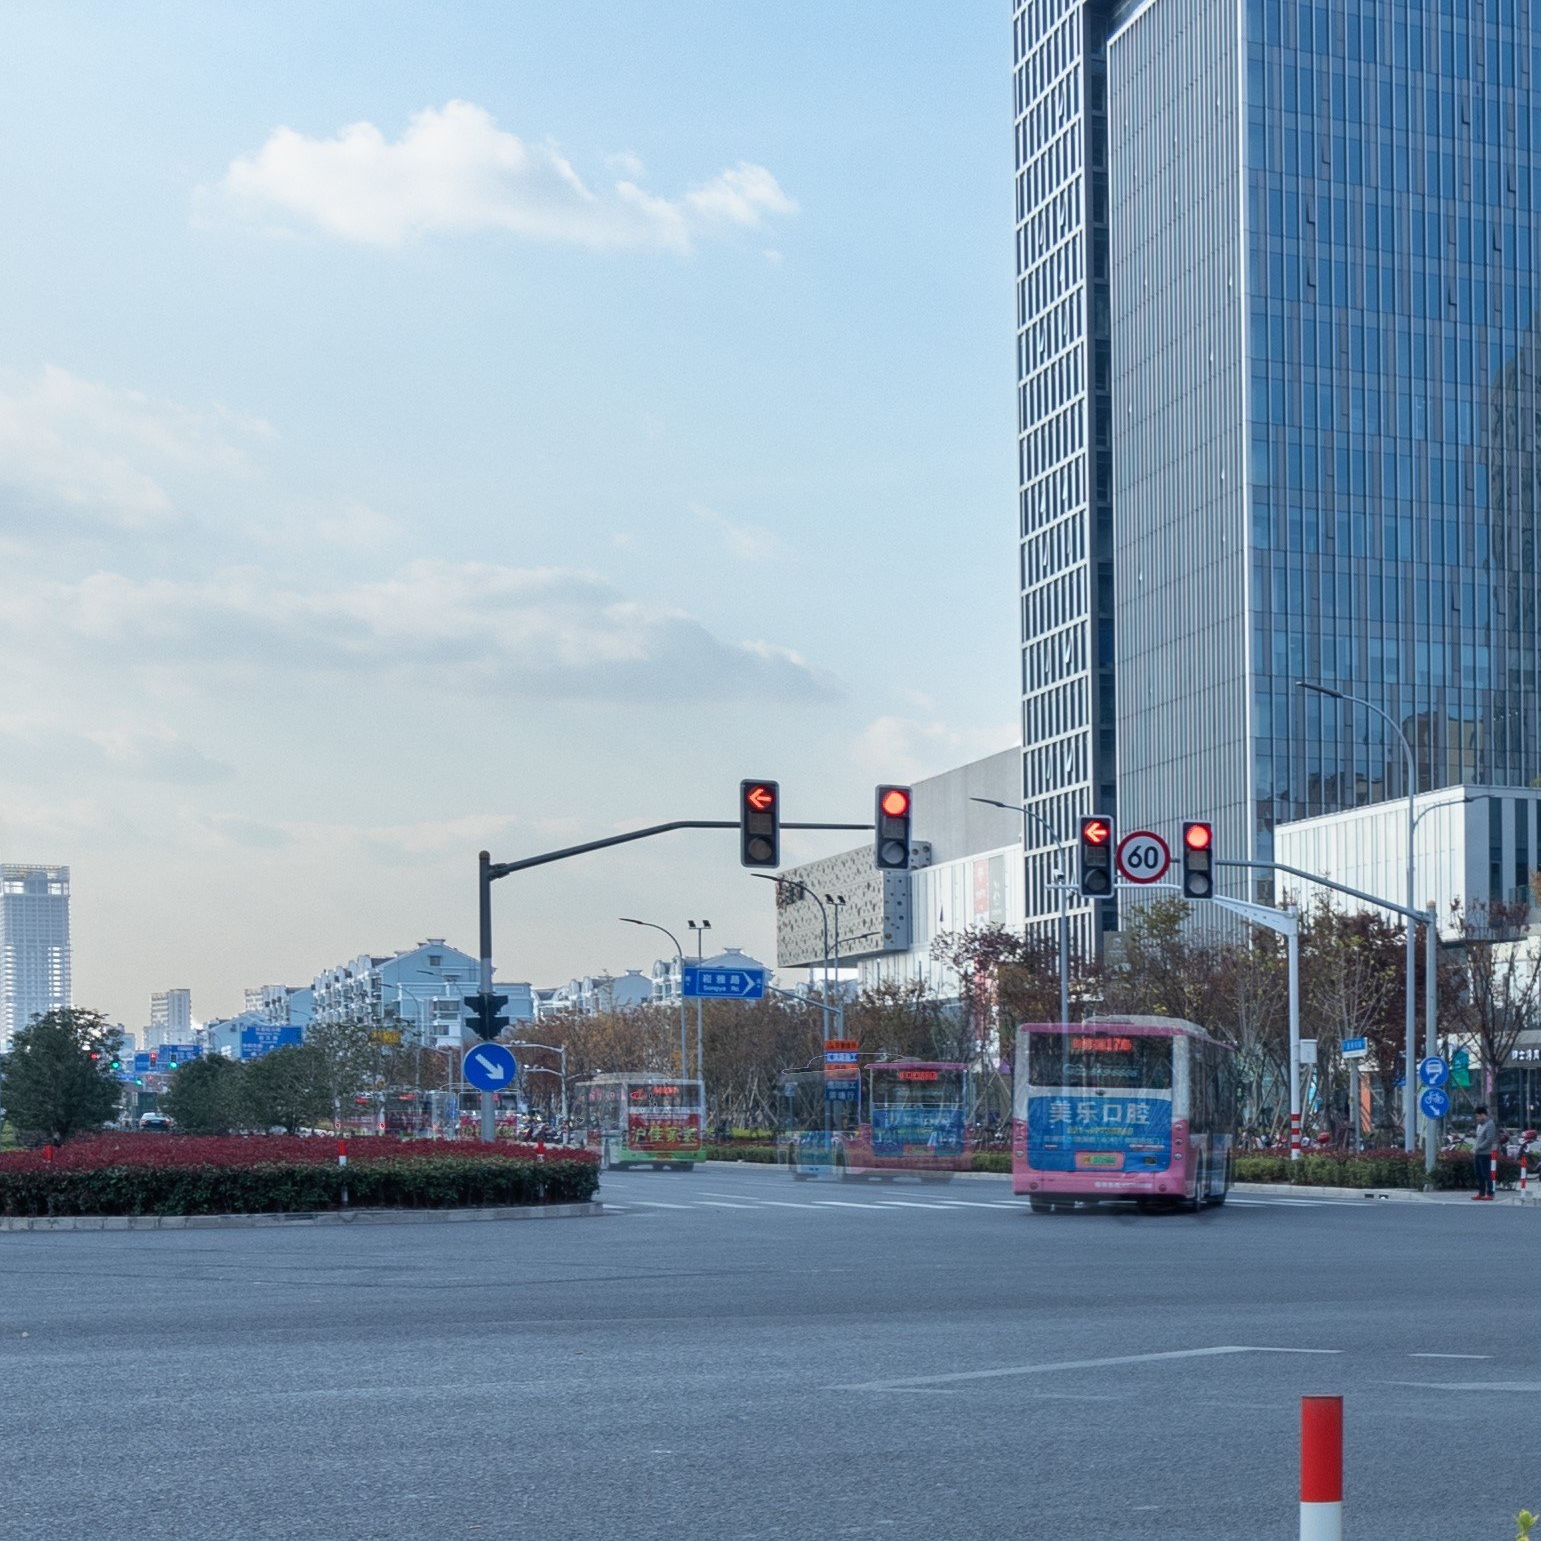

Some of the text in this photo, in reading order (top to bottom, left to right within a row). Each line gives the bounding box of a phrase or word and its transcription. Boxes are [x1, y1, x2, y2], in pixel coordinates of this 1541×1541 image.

[1127, 845, 1159, 869] 60
[1049, 1100, 1152, 1125] 美乐口腔
